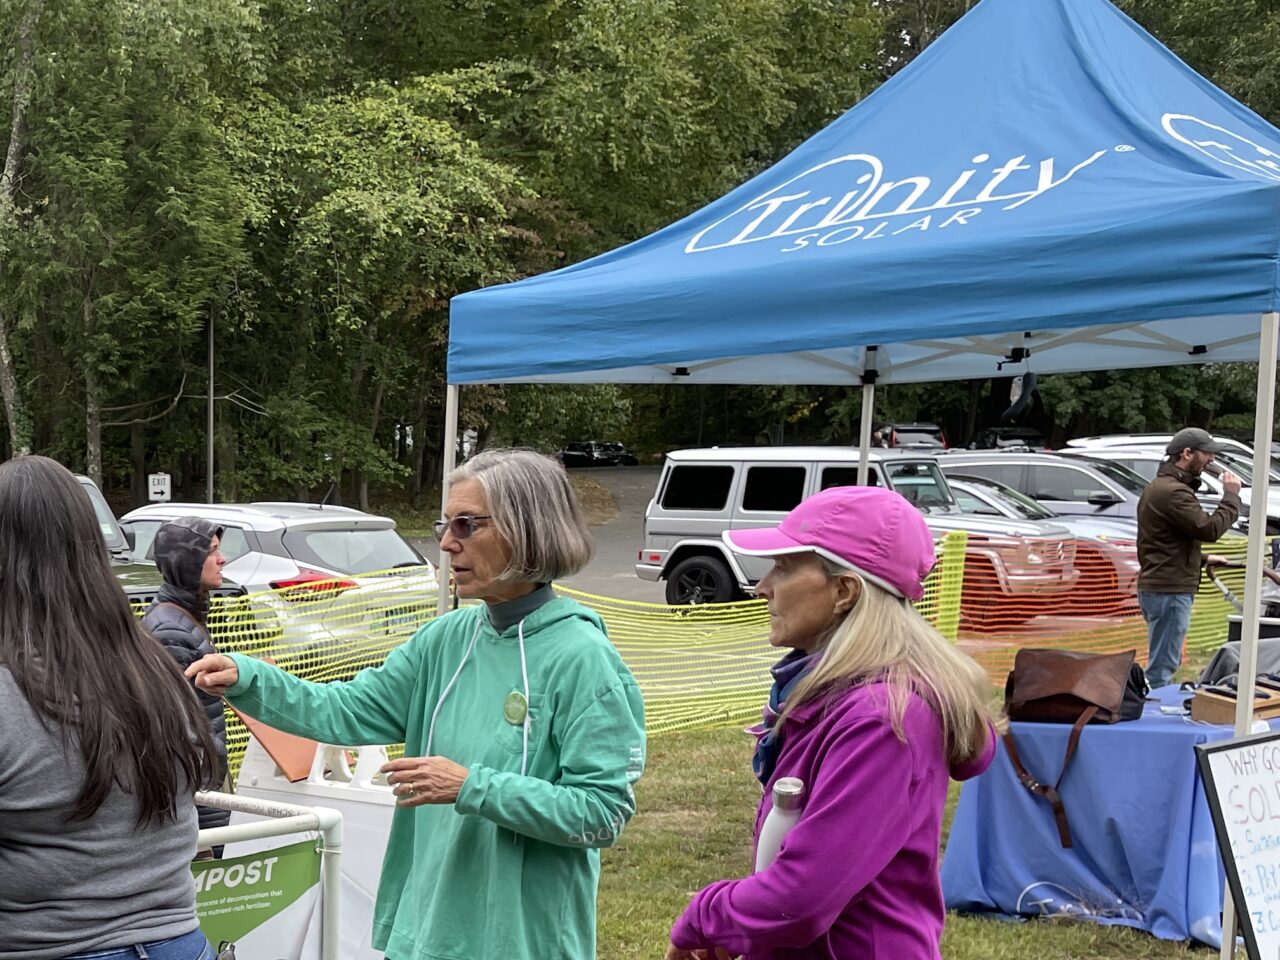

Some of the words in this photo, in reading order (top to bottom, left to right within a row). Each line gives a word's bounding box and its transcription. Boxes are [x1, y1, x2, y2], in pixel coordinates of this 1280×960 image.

[684, 153, 1108, 254] Trinity
[780, 207, 982, 253] SOLAR
[152, 477, 167, 487] EXIT
[1225, 747, 1258, 777] WHY
[227, 891, 269, 903] decomposition
[271, 889, 283, 897] that
[208, 904, 245, 916] nutrient-rich
[246, 901, 271, 910] fertilizer
